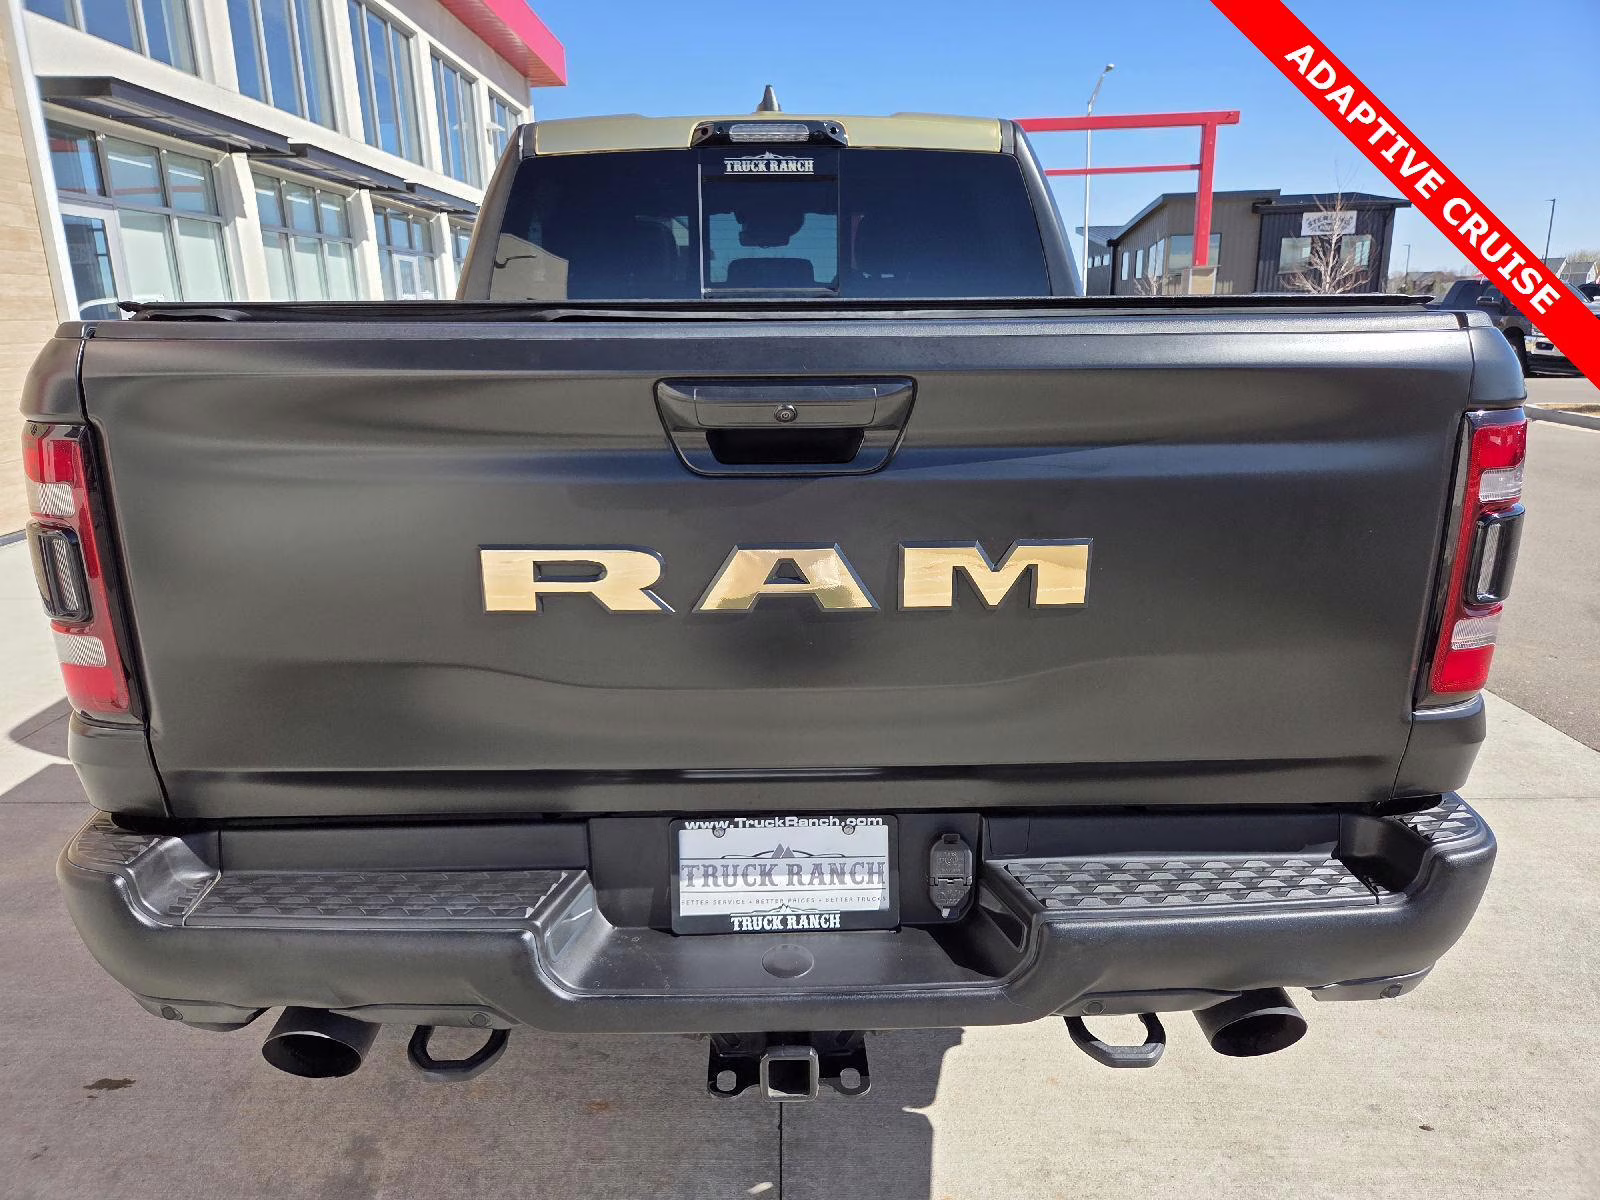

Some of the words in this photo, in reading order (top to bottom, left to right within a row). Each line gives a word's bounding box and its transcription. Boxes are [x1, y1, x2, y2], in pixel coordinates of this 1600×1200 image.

[724, 160, 768, 172] TRUCK
[769, 160, 815, 172] RANCH
[479, 538, 1093, 614] RAM
[684, 816, 883, 830] www.TruckRanch.com
[681, 863, 779, 888] TRUCK
[786, 861, 886, 887] RANCH
[731, 915, 785, 931] TRUCK
[786, 914, 841, 930] RANCH
